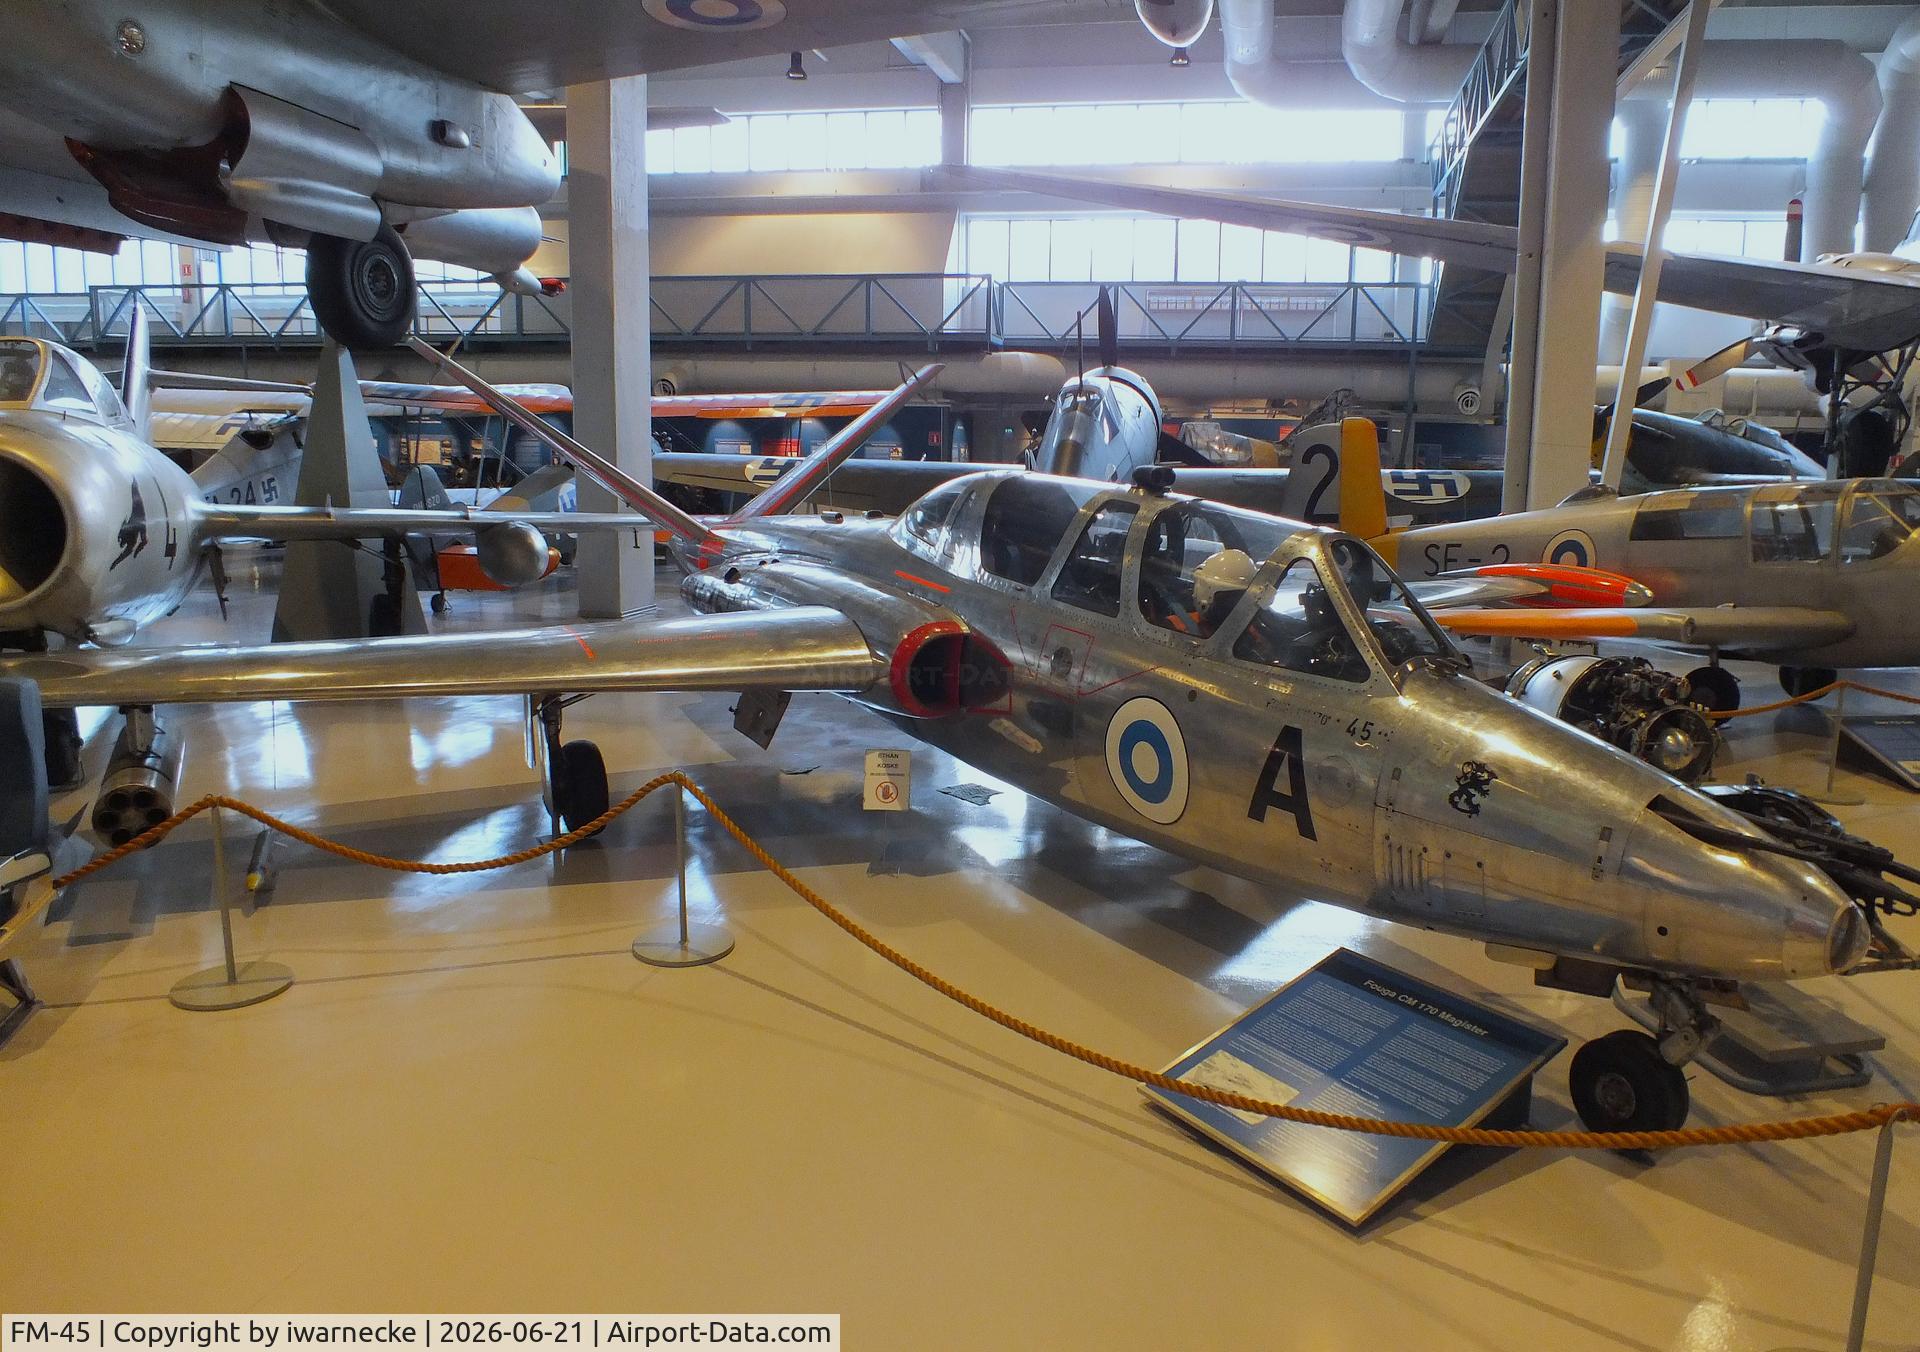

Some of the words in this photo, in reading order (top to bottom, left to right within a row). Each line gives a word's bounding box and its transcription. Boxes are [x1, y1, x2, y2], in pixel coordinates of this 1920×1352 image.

[1302, 444, 1339, 523] 2
[1346, 718, 1375, 741] 45
[1247, 724, 1318, 842] A
[1363, 979, 1397, 998] Fouga
[1398, 994, 1418, 1006] CM
[1418, 1003, 1439, 1016] 170
[1439, 1010, 1489, 1036] Magister
